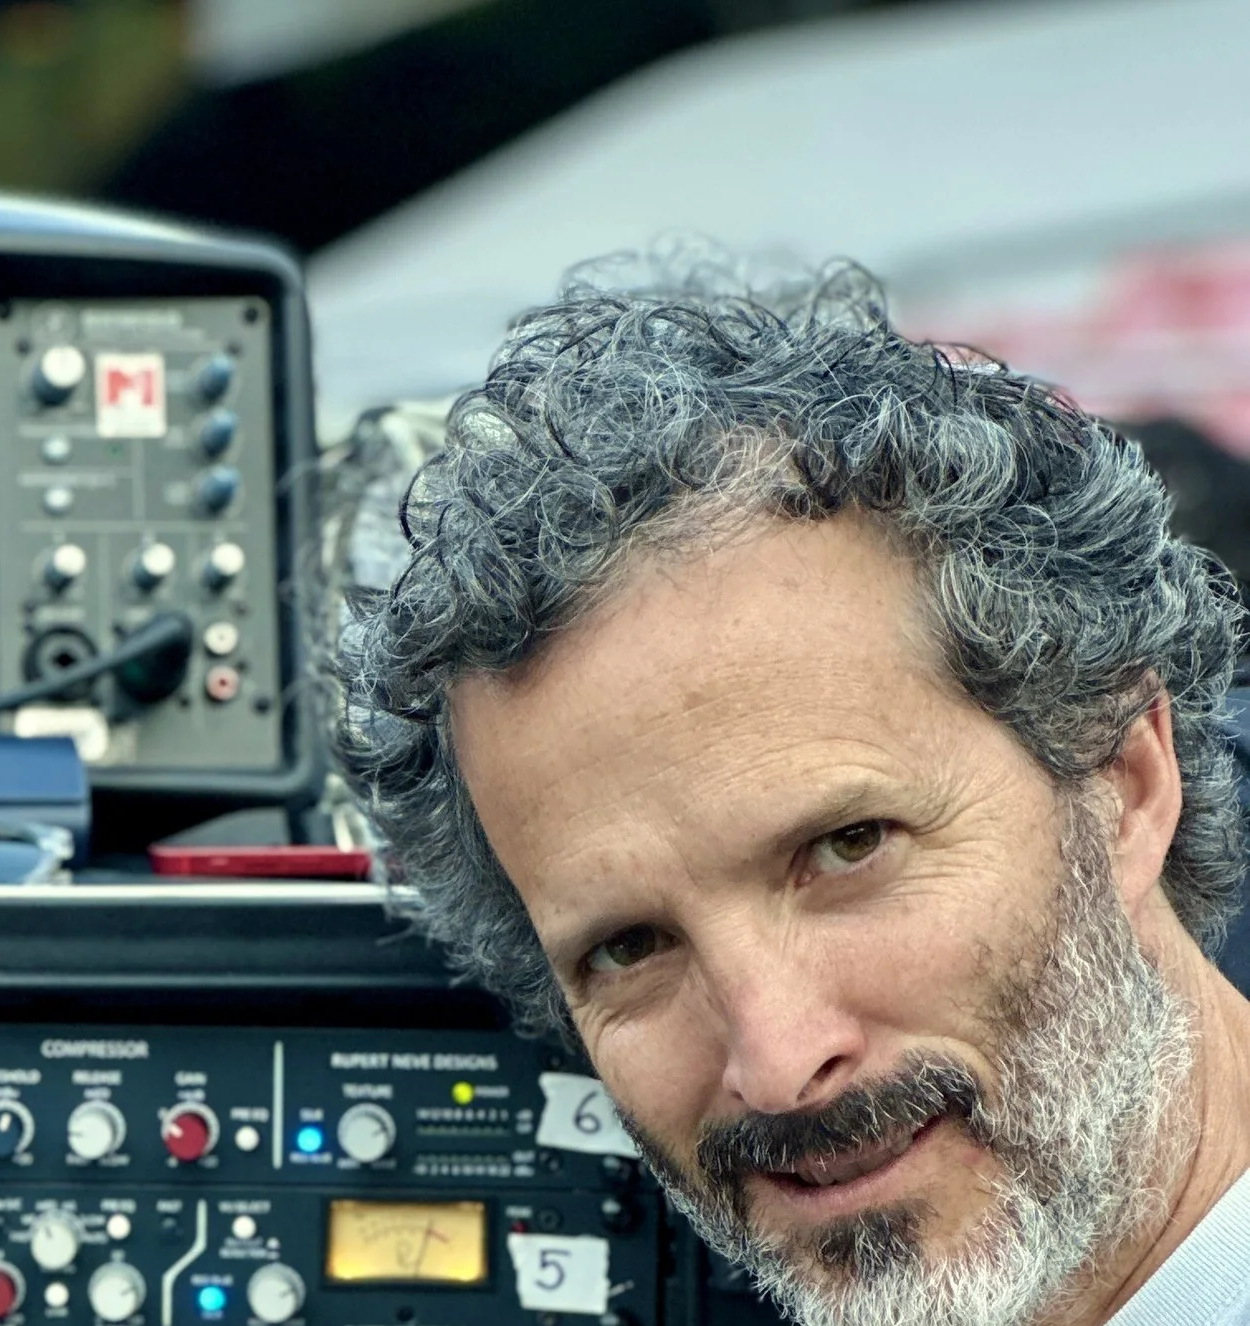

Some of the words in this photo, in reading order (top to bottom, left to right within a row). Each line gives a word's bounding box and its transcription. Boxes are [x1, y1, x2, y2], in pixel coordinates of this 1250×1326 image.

[40, 1040, 149, 1059] COMPRESSOR
[331, 1053, 388, 1069] RUPERT
[392, 1054, 430, 1070] NEVE
[433, 1054, 499, 1071] DESIGNS
[574, 1091, 601, 1134] 6
[534, 1248, 572, 1291] 5
